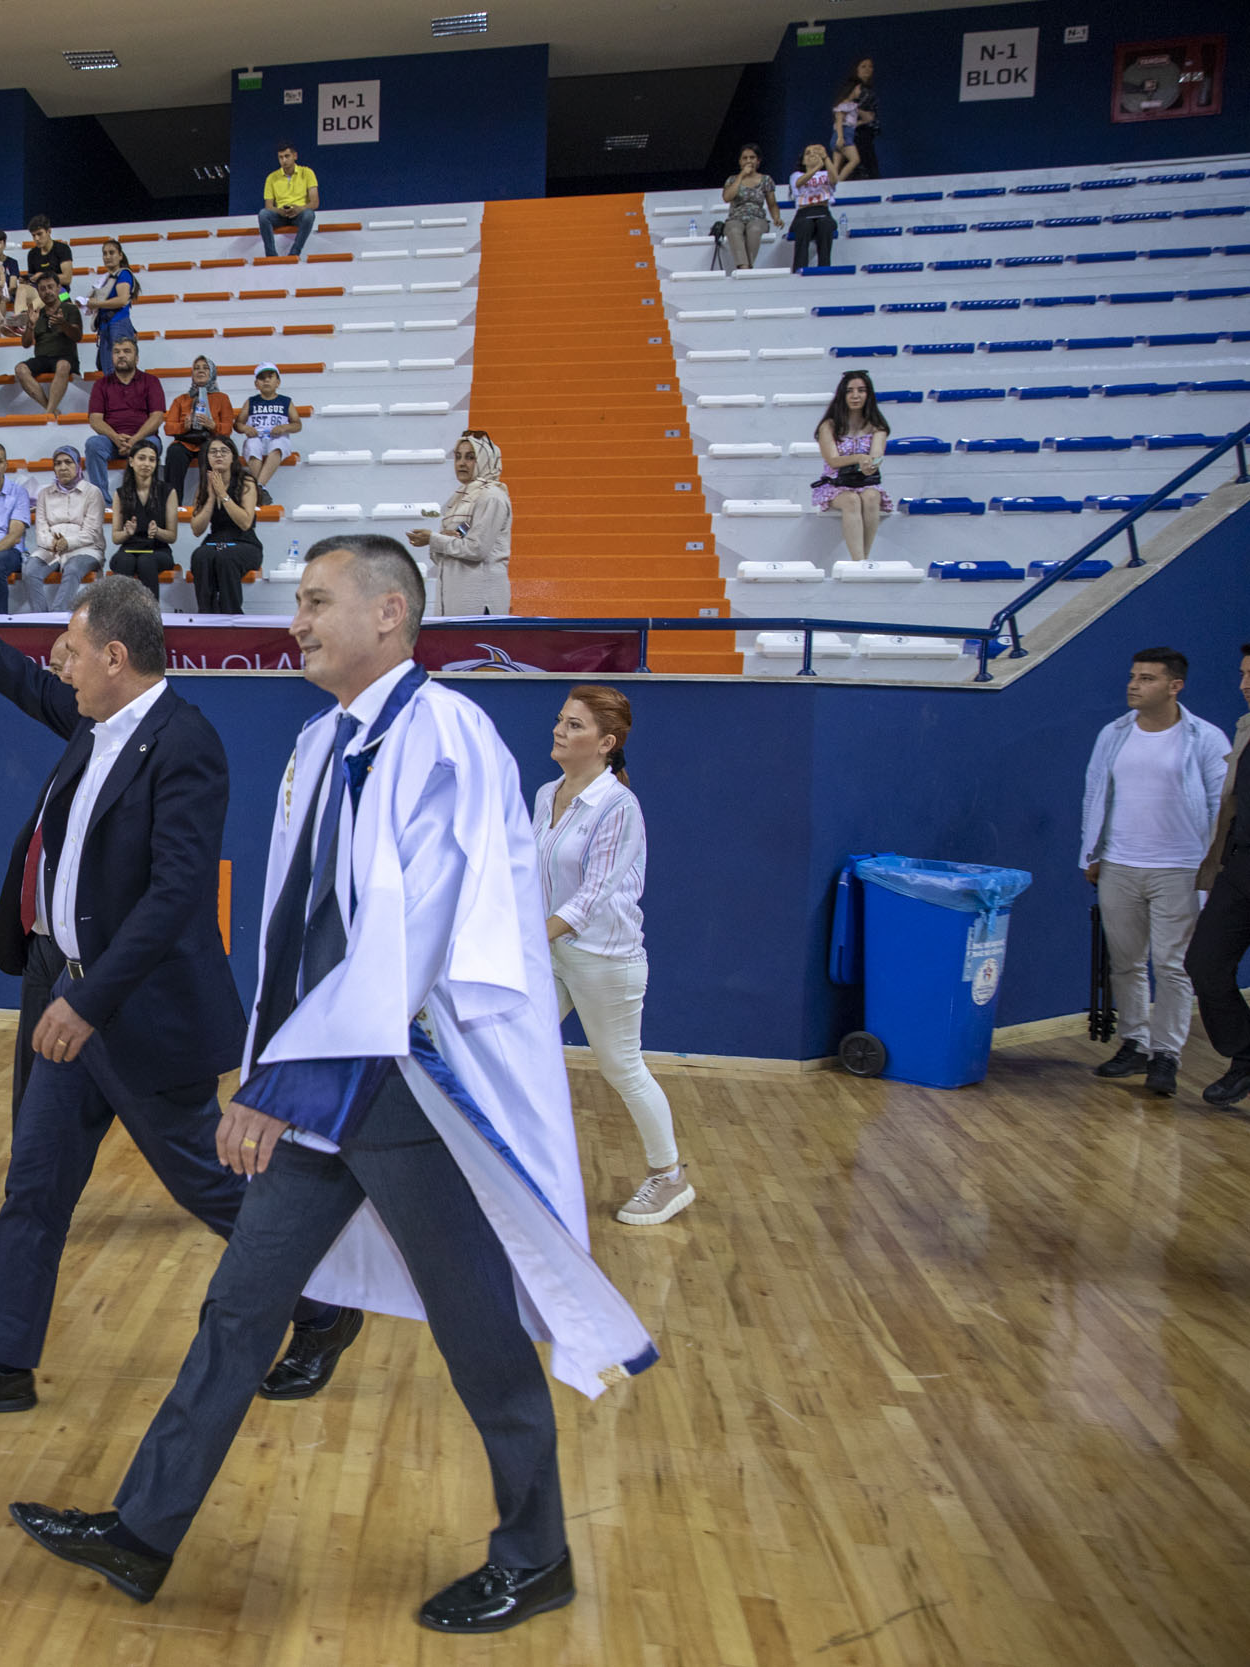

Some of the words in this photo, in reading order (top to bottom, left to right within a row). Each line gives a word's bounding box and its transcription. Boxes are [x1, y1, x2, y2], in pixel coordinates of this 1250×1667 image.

[980, 42, 1018, 61] N-1
[966, 66, 1029, 87] BLOK
[332, 93, 366, 109] M-1
[322, 115, 374, 132] BLOK
[253, 404, 285, 414] LEAGUE
